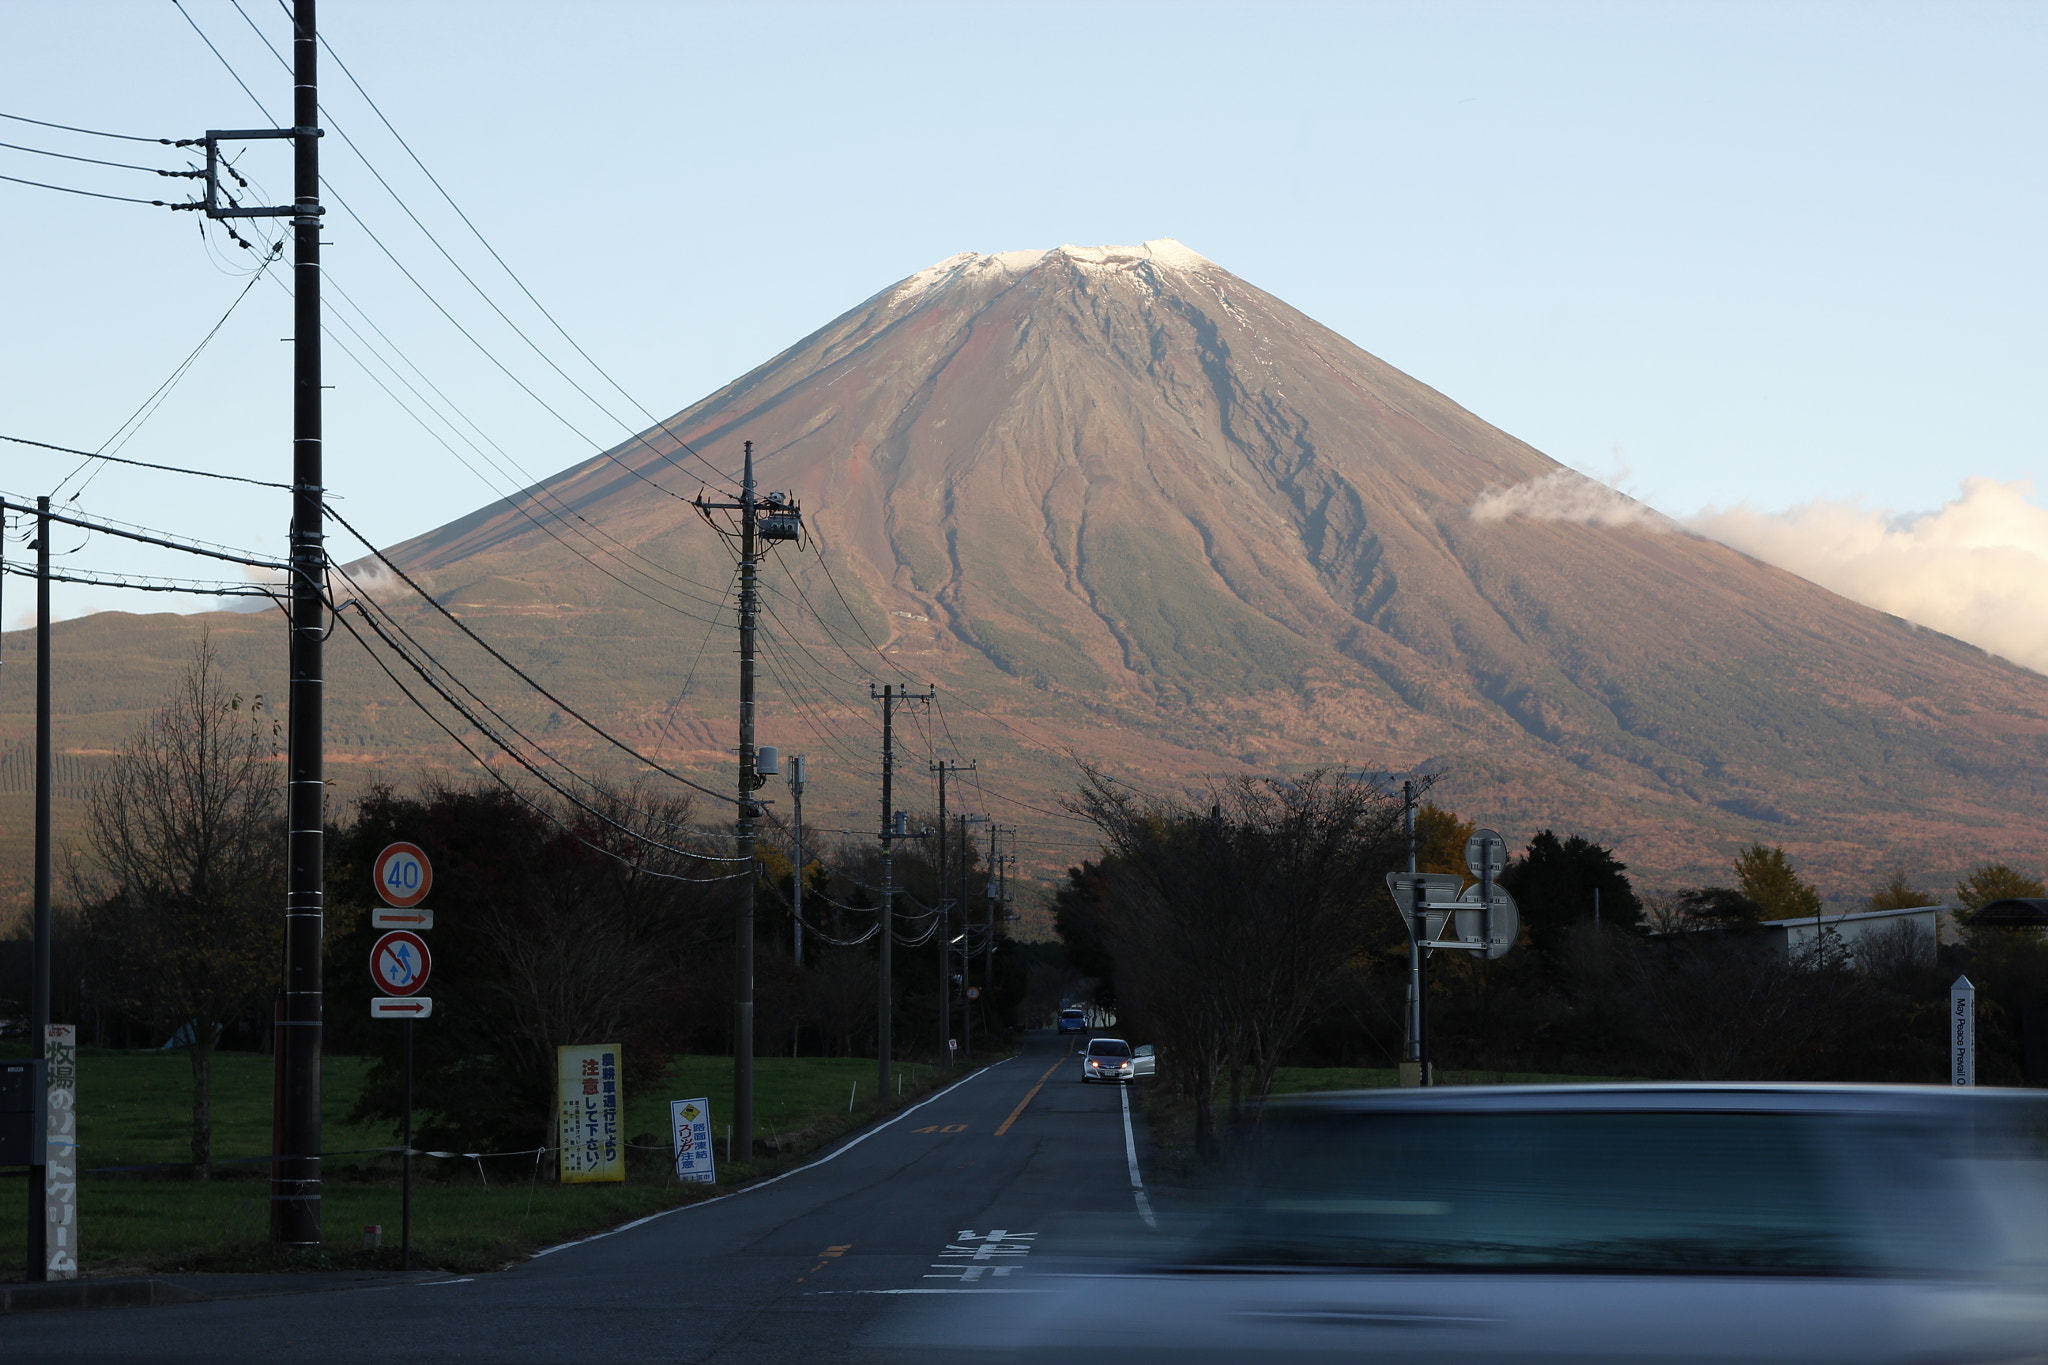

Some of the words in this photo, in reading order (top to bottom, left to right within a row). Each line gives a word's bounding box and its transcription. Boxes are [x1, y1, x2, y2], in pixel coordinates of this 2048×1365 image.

[387, 861, 418, 889] 40
[1956, 998, 1965, 1016] May
[1956, 1019, 1965, 1046] Peace
[1956, 1048, 1966, 1076] Prevail
[602, 1053, 616, 1161] 農耕車通行により
[693, 1123, 708, 1159] 路面凍結
[910, 1124, 969, 1134] 40
[46, 1041, 76, 1271] 牧場のソフトクリーム
[679, 1124, 694, 1169] スリップ注意
